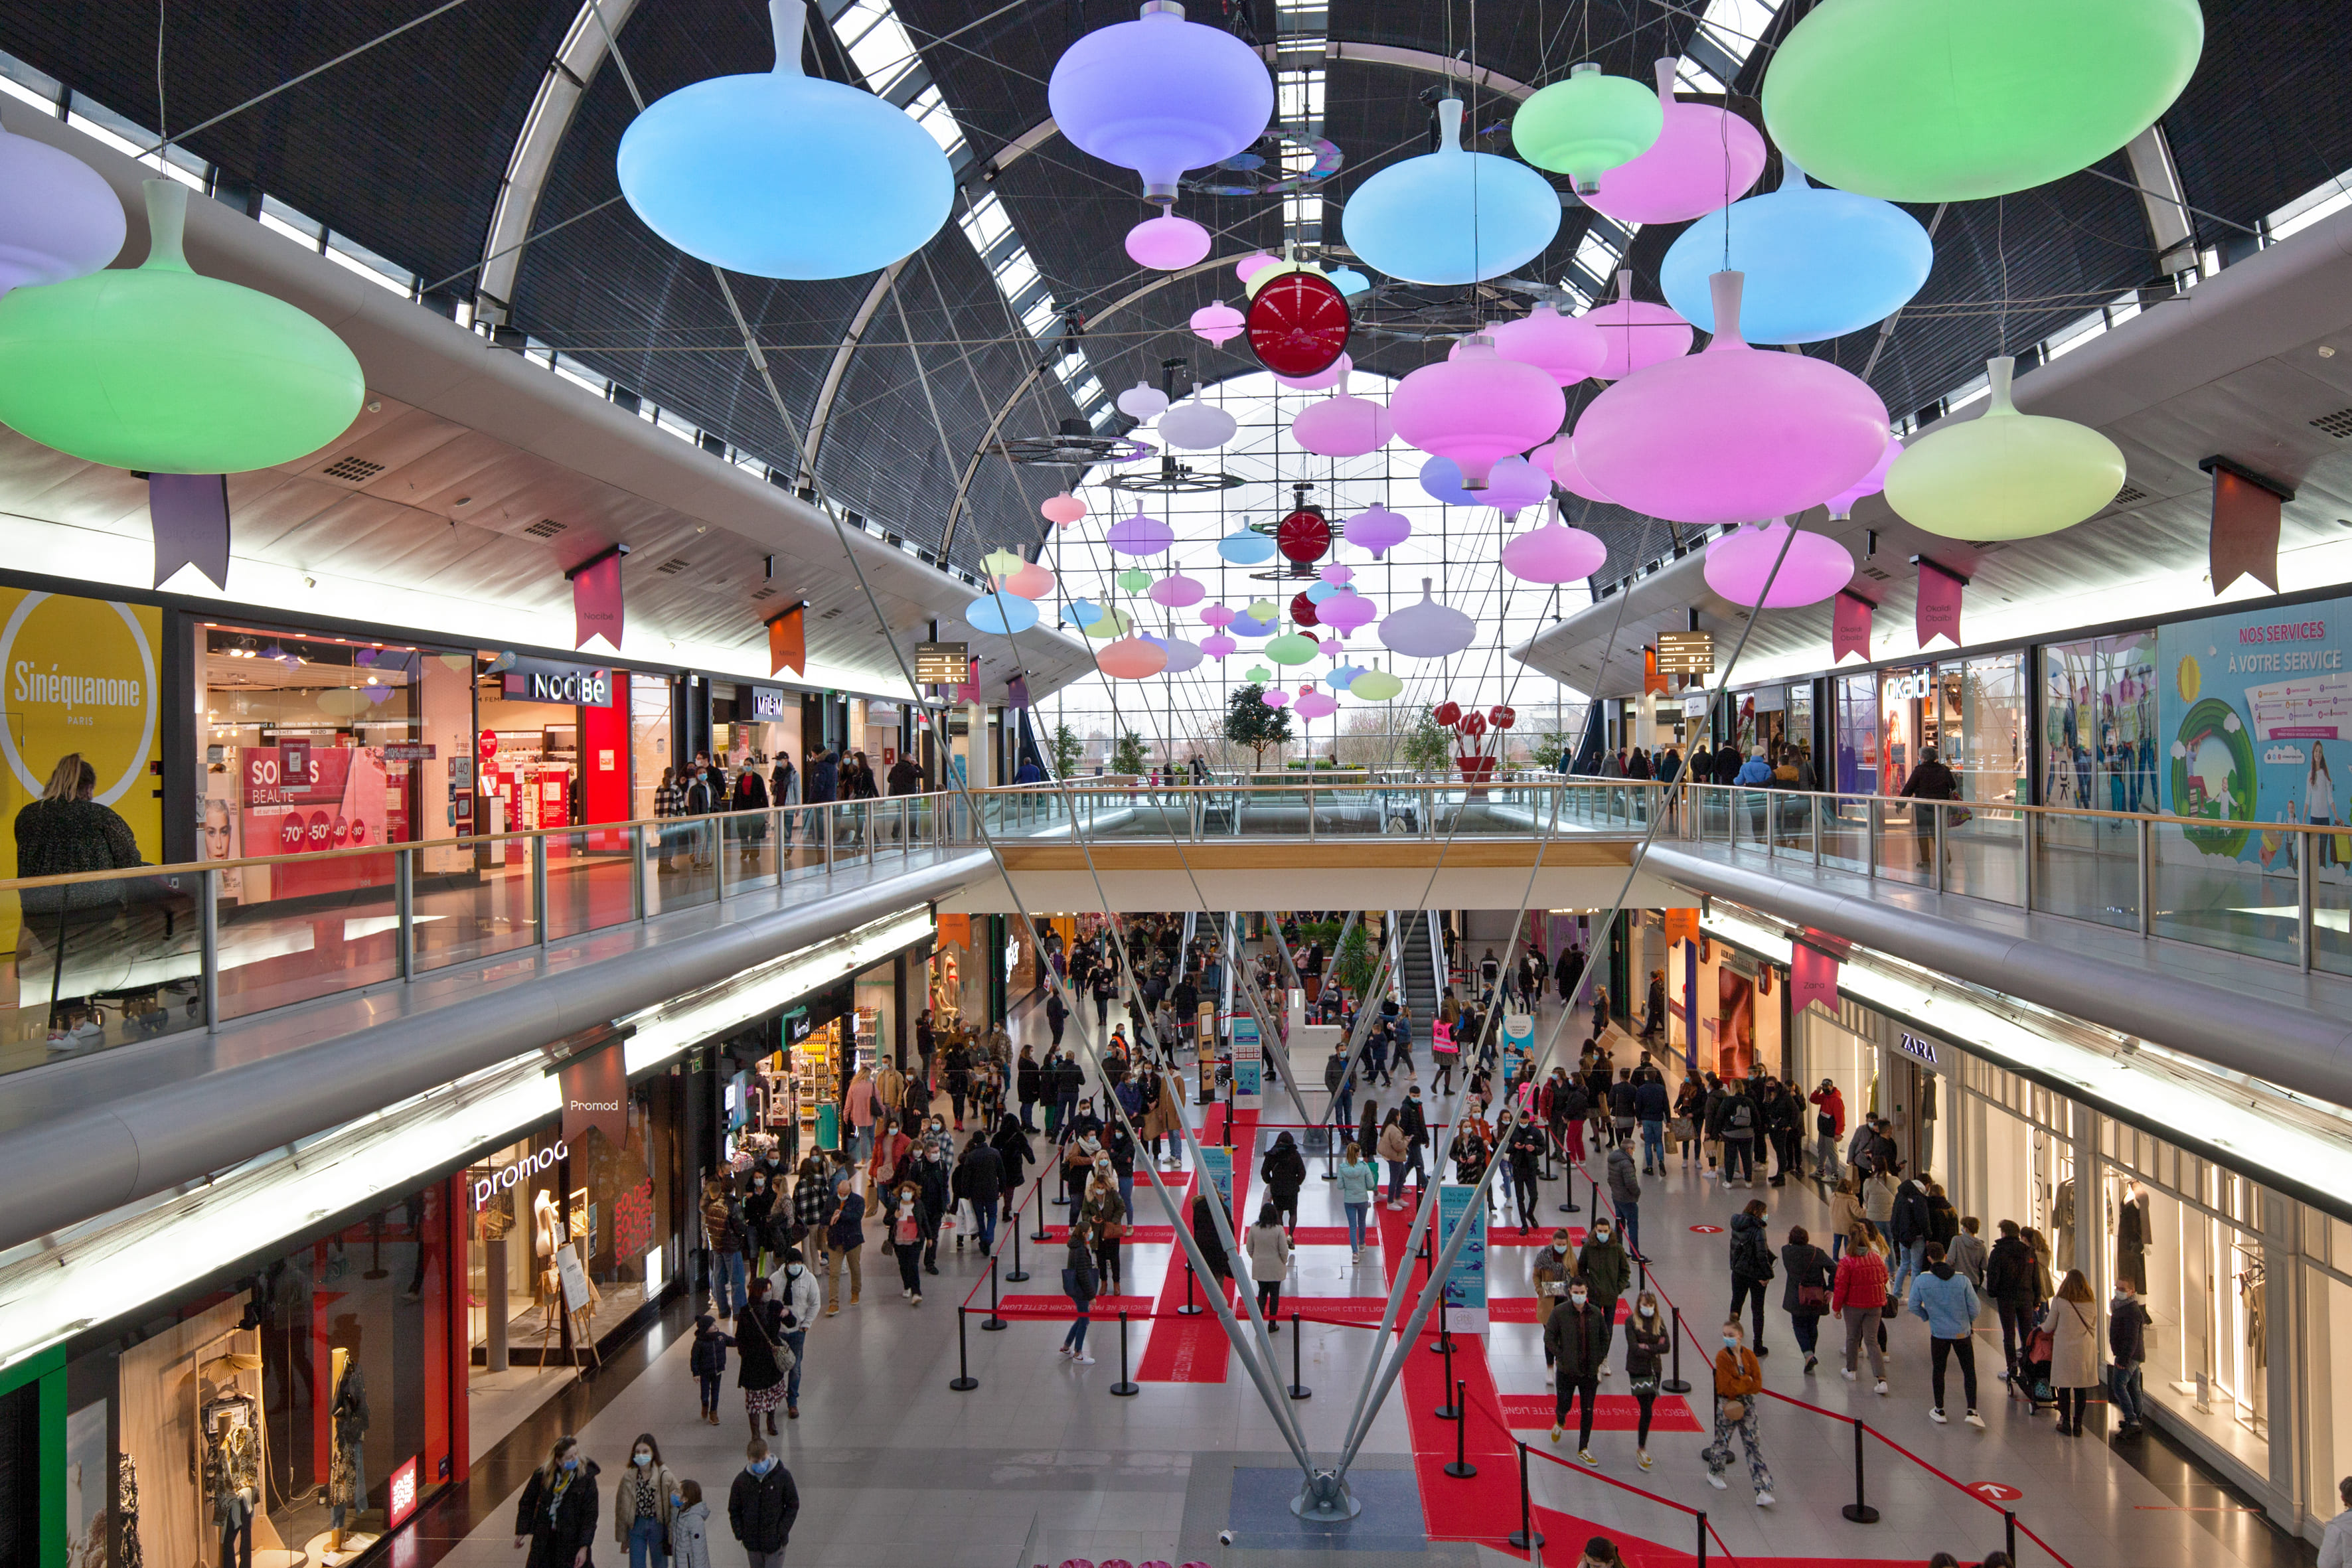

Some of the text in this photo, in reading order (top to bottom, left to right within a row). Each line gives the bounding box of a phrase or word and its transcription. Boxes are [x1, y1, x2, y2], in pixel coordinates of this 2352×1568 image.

[584, 611, 614, 621] Nocibé
[2239, 620, 2325, 644] NOS SERVICES
[2228, 649, 2342, 673] À VOTRE SERVICE
[15, 660, 139, 710] Sinéquanone
[67, 716, 94, 726] PARIS
[252, 760, 319, 785] SOS
[282, 826, 304, 842] -70%
[308, 824, 330, 840] -50%
[793, 1017, 811, 1040] Normal
[1901, 1032, 1938, 1063] ZARA
[570, 1099, 619, 1111] Promod
[1503, 1406, 1529, 1415] LIGNE
[1613, 1407, 1632, 1416] PAS
